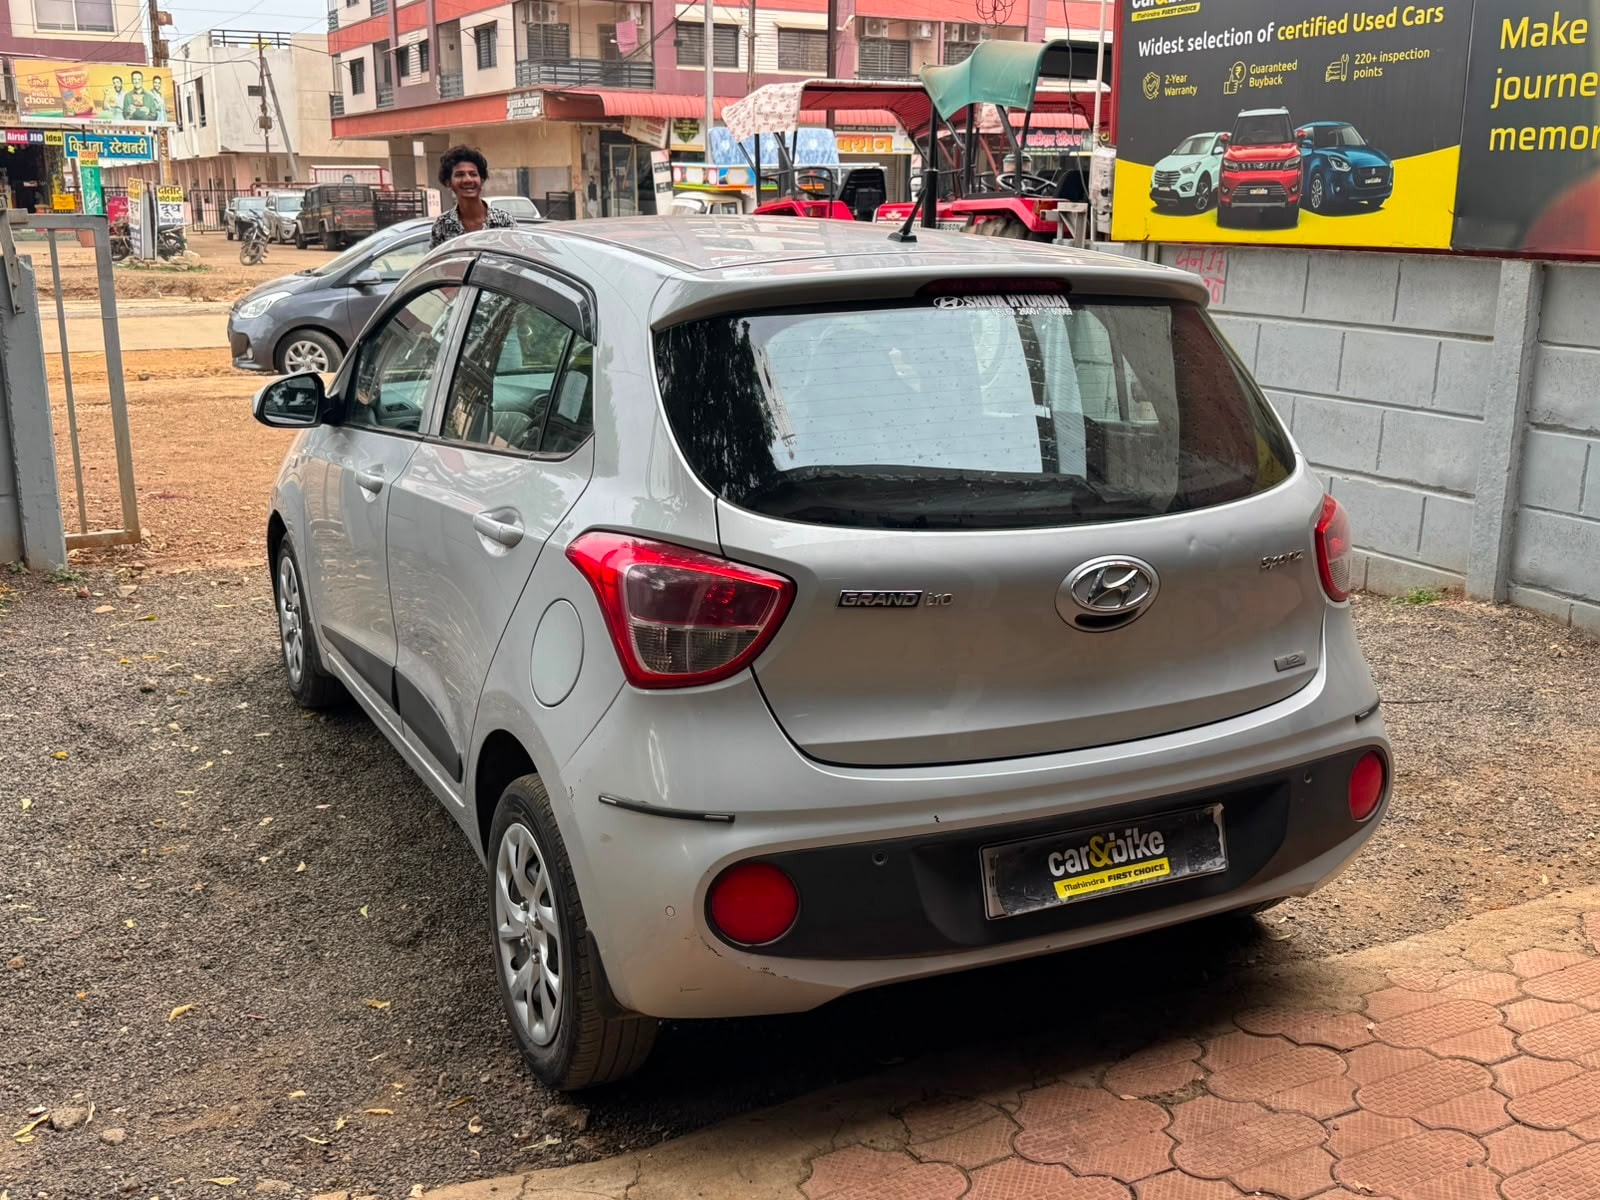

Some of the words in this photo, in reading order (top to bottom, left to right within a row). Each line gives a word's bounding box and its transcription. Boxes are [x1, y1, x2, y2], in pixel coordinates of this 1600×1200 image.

[1177, 4, 1197, 13] CHOICE
[1138, 36, 1184, 57] Widest
[1187, 27, 1253, 52] selection
[1256, 21, 1275, 43] of
[1276, 12, 1349, 41] certified
[1352, 6, 1398, 32] Used
[1402, 5, 1444, 27] Cars
[1500, 11, 1588, 50] Make
[1354, 53, 1377, 65] 220+
[1379, 47, 1430, 64] inspection
[1249, 59, 1298, 75] Guaranteed
[1353, 67, 1383, 81] points
[1164, 74, 1188, 85] 2-Year
[1249, 74, 1283, 88] Buyback
[1164, 85, 1198, 97] Warranty
[7, 132, 28, 141] Airtel
[109, 137, 148, 154] स्टेशनरी
[963, 295, 1007, 309] SHIVA
[1006, 294, 1070, 309] HYUNDAI
[840, 592, 920, 607] GRAND
[925, 592, 954, 606] i10
[1048, 828, 1166, 877] car&bike
[1063, 876, 1106, 892] Mahindra
[1106, 870, 1133, 883] FIRST
[1133, 863, 1166, 877] CHOICE
